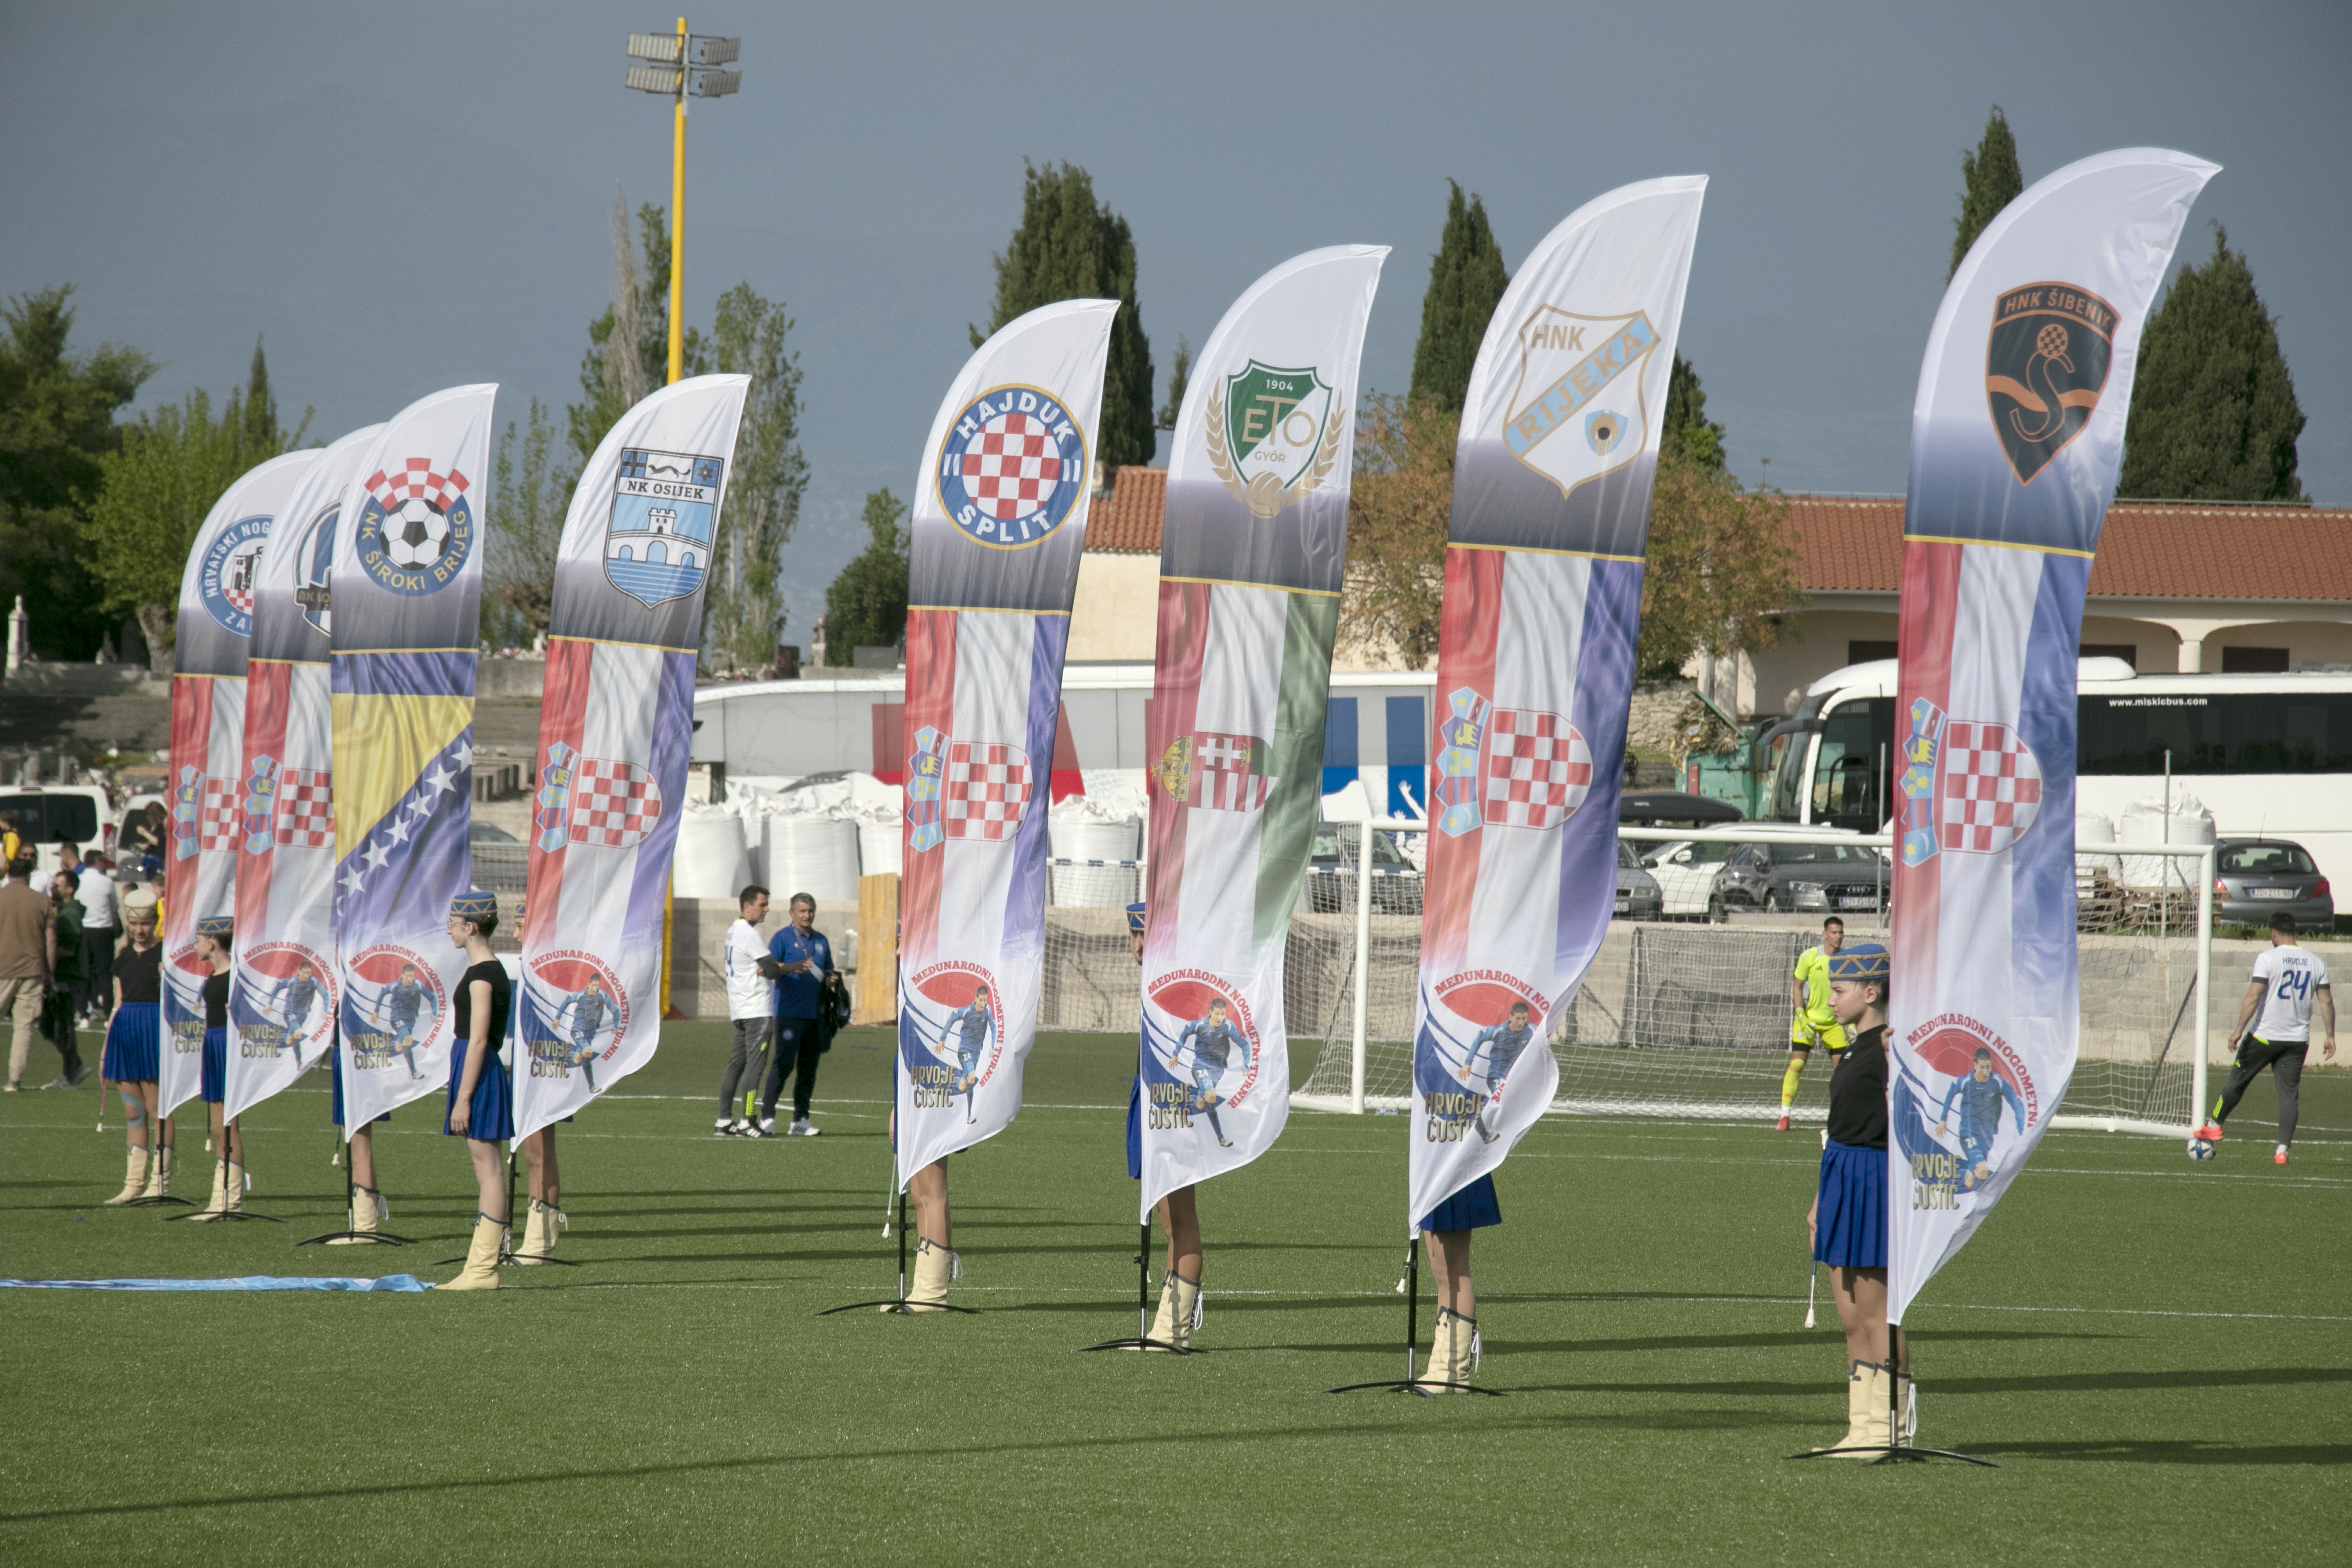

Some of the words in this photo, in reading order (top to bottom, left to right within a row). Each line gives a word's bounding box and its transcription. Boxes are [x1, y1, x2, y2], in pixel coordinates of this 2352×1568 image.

[2004, 291, 2043, 314] HNK
[2047, 288, 2111, 330] ŠIBENIK
[1531, 324, 1587, 351] HNK
[1266, 379, 1294, 391] 1904
[1516, 331, 1645, 443] RIJEKA
[956, 391, 1075, 445] HAJDUK
[1242, 395, 1316, 447] ETO
[1255, 450, 1286, 463] GYŐR
[627, 480, 649, 493] NK
[653, 483, 704, 499] OSIJEK
[362, 511, 379, 539] NK
[958, 504, 1051, 541] SPLIT
[434, 510, 467, 582] BRIJEG
[205, 531, 238, 597] HRVATSKI
[365, 550, 425, 590] ŠIROKI
[2109, 696, 2208, 707] www.miskicbus.com
[911, 960, 991, 986] MEĐUNARODNI
[2277, 970, 2311, 1000] 24
[603, 965, 630, 1024] NOGOMETNI
[1434, 970, 1534, 996] MEĐUNARODNI
[1531, 991, 1550, 1014] NO
[989, 976, 1005, 1044] NOGOMETNI
[1229, 989, 1261, 1062] NOGOMETNI
[421, 1013, 445, 1048] TURNIR
[601, 1026, 627, 1061] TURNIR
[1906, 1013, 1993, 1046] MEĐUNARODNI
[910, 1066, 958, 1086] HRVOJE
[979, 1046, 1002, 1087] TURNIR
[1197, 1069, 1209, 1078] 24
[914, 1085, 953, 1108] ČUSTIĆ
[1227, 1064, 1259, 1109] TURNIR
[1425, 1092, 1486, 1115] HRVOJE
[1965, 1138, 1977, 1148] 24
